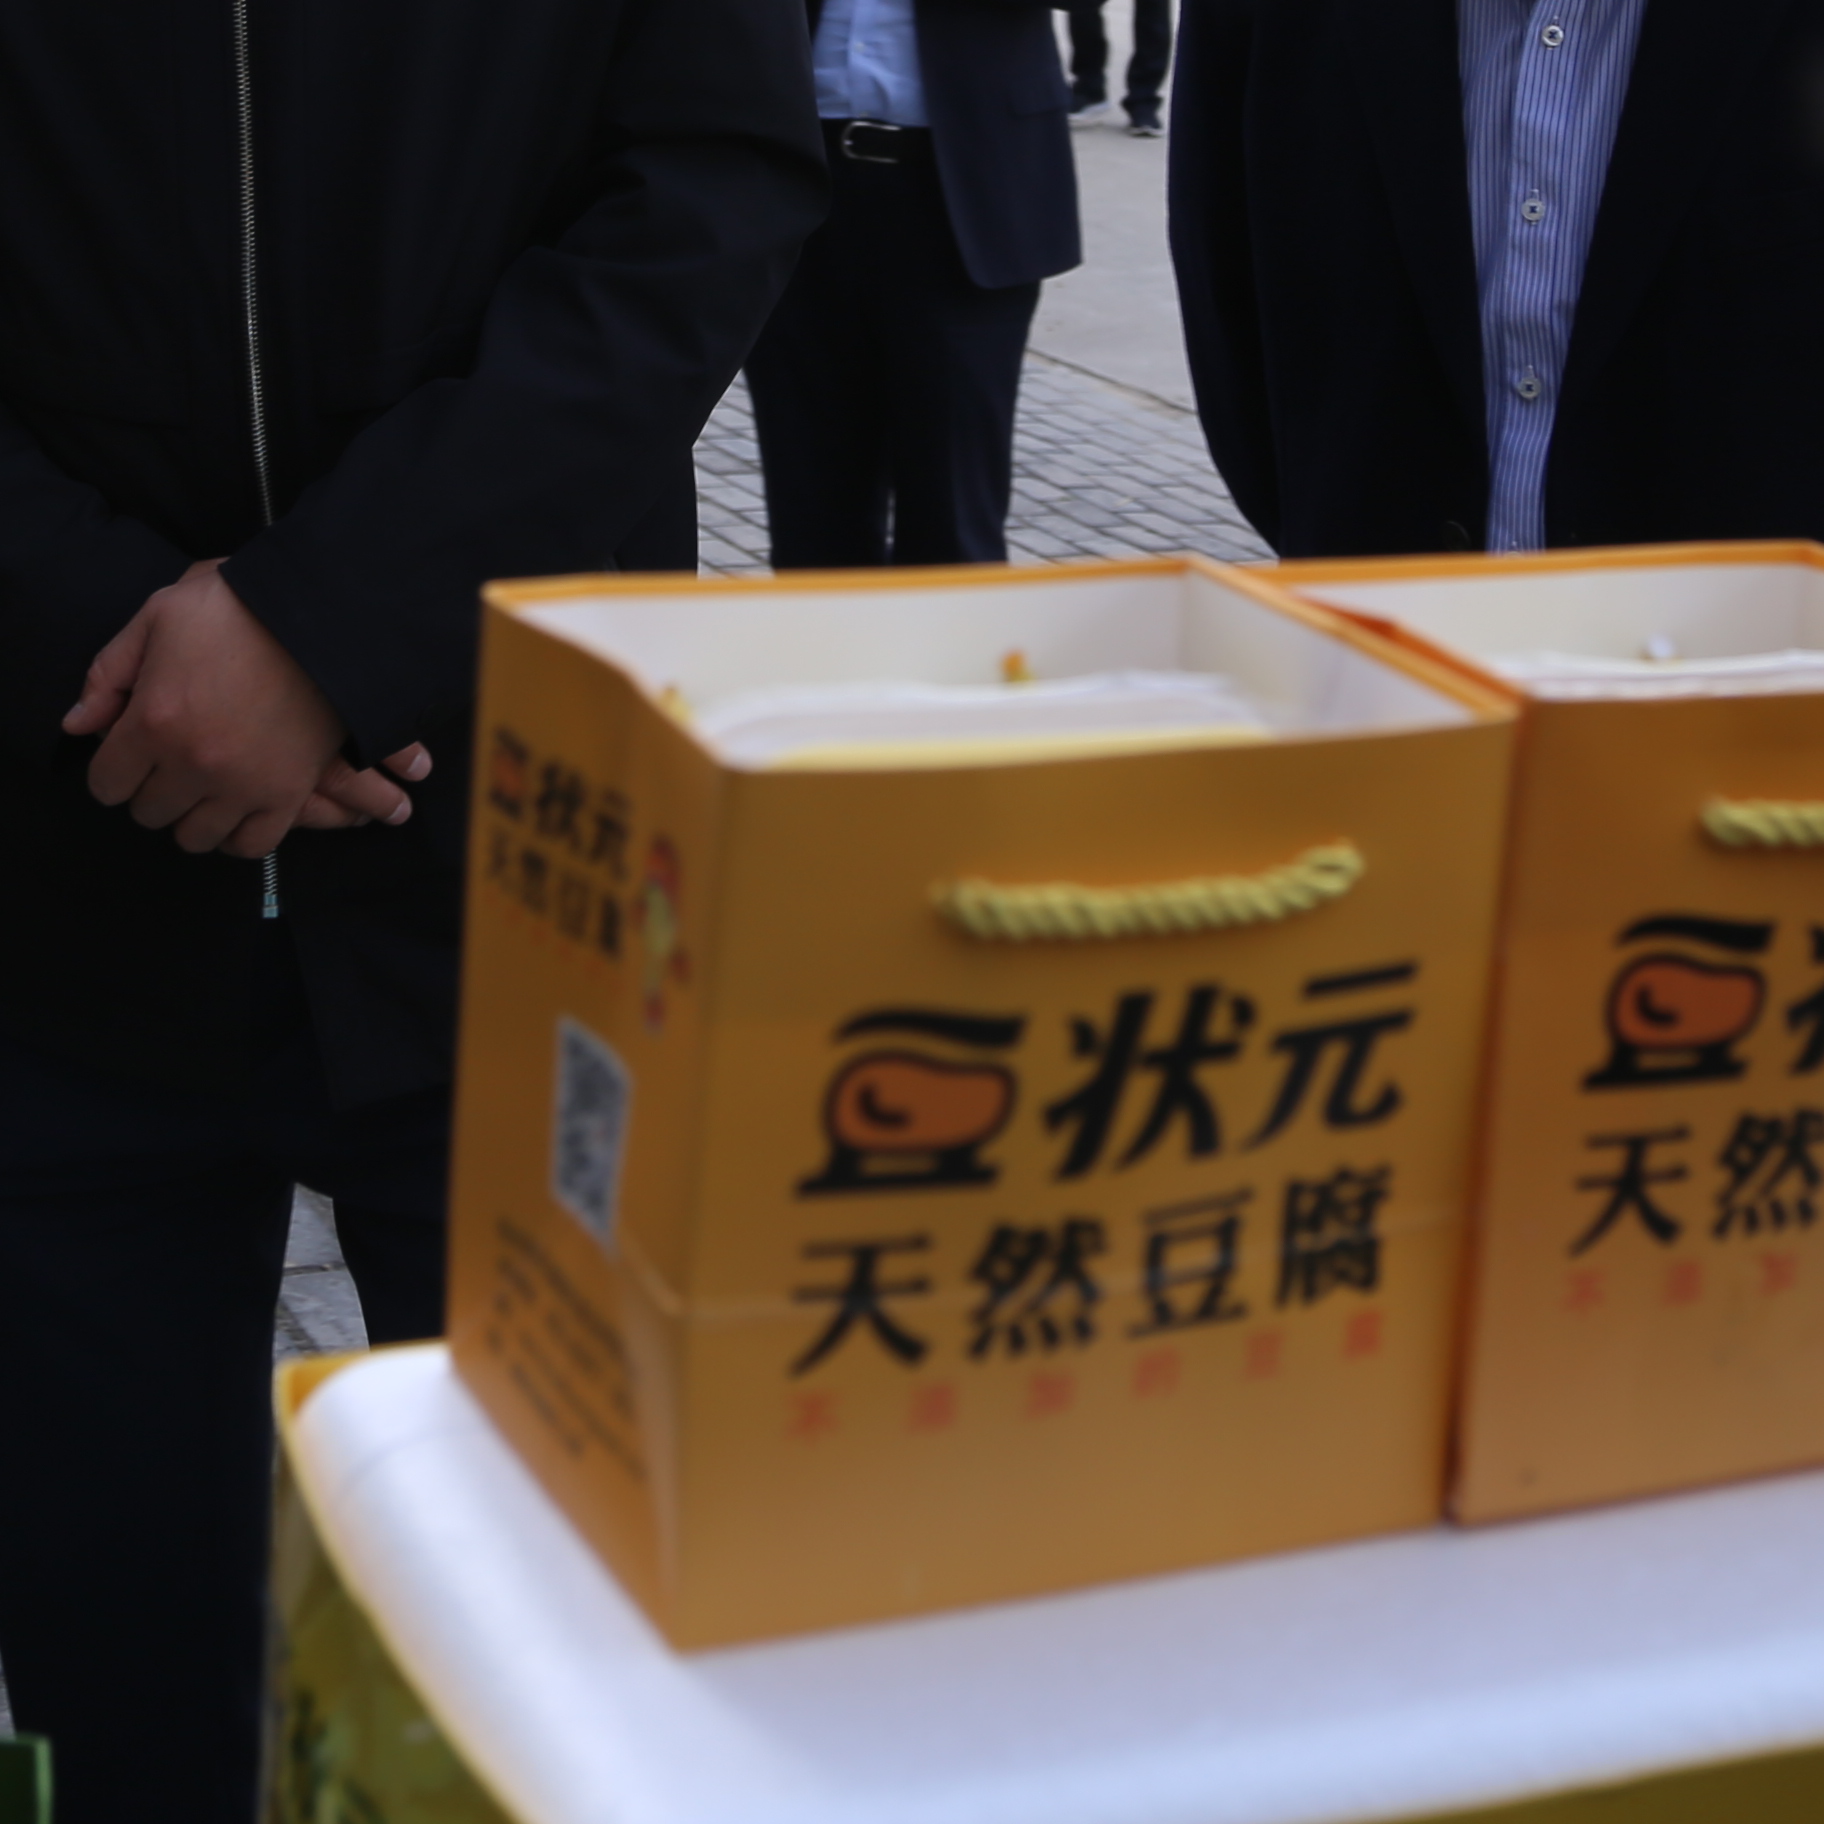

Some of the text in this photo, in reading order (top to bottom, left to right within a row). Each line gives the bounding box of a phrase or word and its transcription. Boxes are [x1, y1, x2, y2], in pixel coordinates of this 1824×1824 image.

[793, 961, 1418, 1198] 豆状元
[791, 1165, 1393, 1378] 天然豆腐
